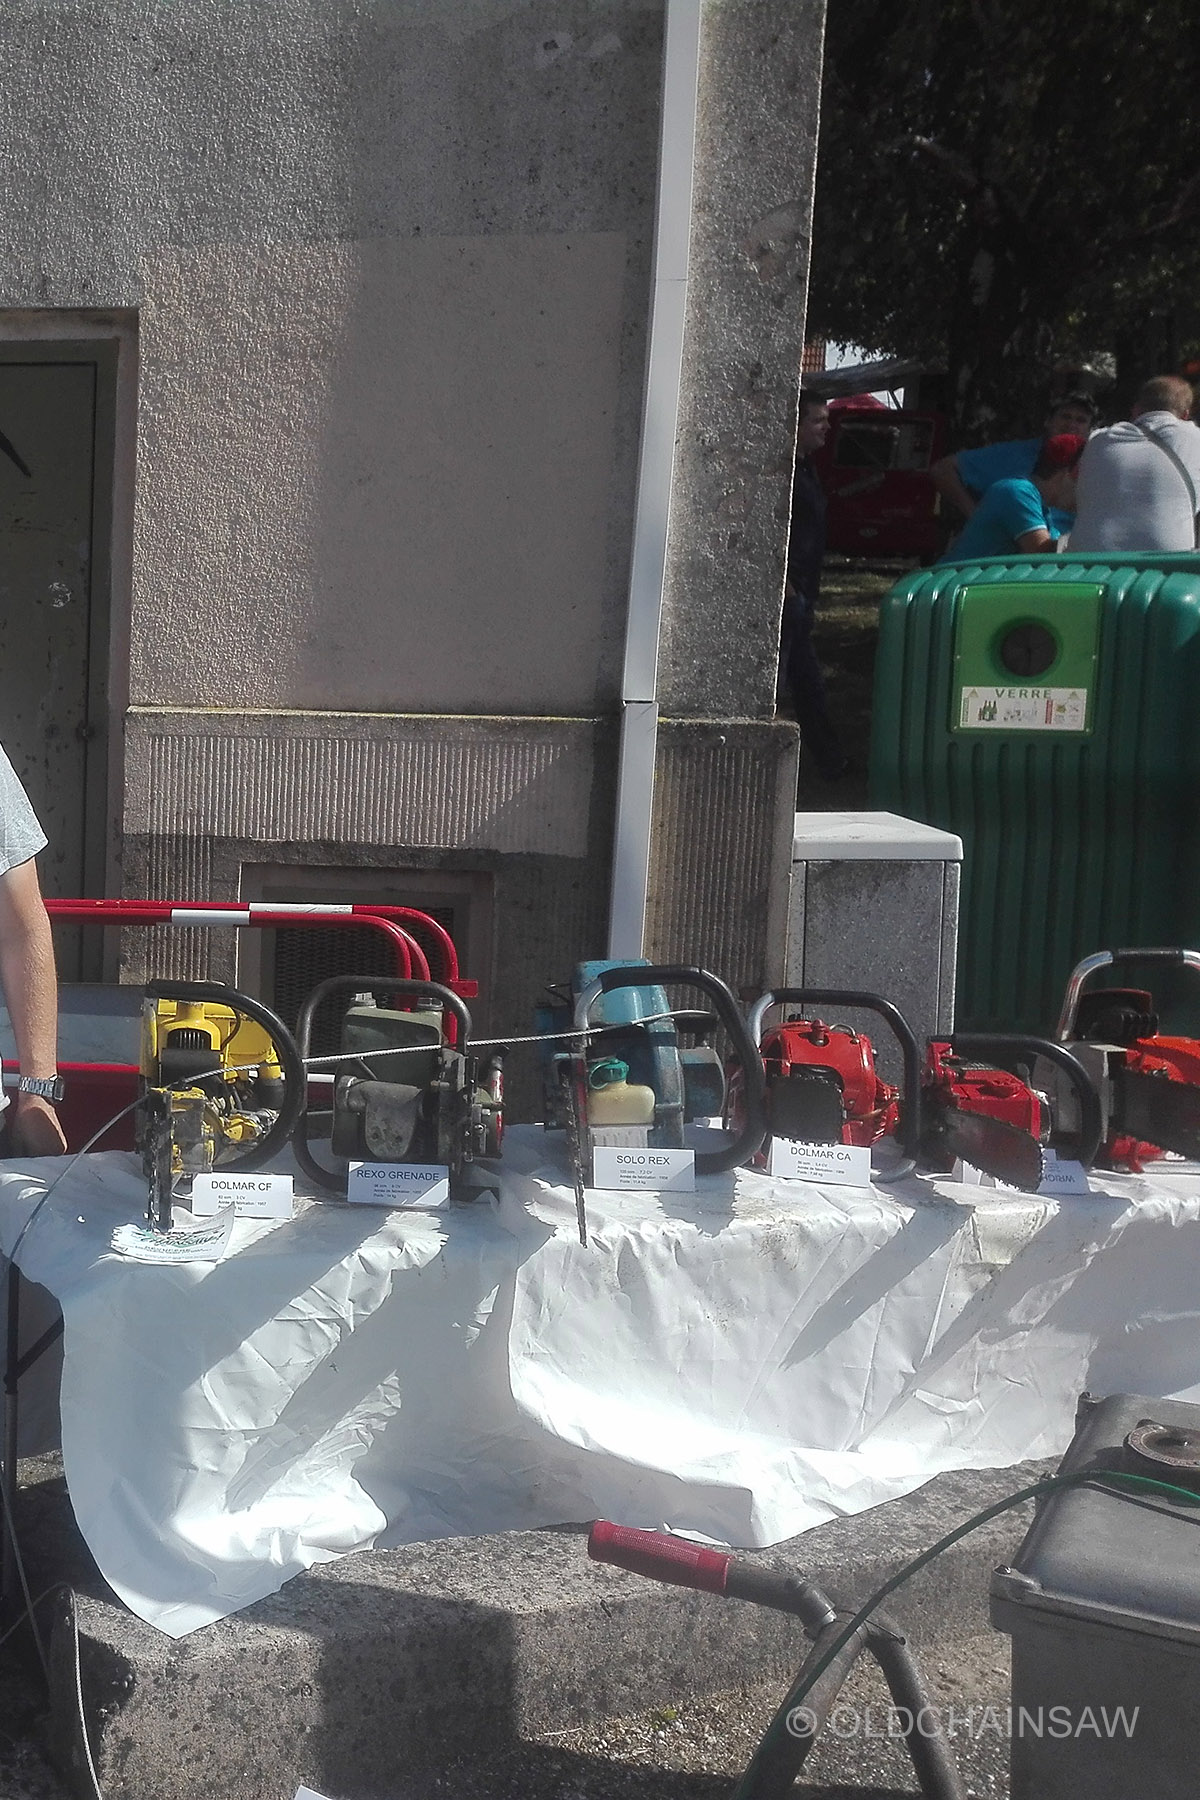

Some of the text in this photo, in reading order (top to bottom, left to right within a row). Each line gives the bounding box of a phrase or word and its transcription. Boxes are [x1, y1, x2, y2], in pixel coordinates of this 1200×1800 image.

[995, 689, 1052, 699] VERRE
[790, 1146, 851, 1161] DOLMAR CA
[616, 1155, 670, 1165] SOLO REX
[356, 1169, 440, 1181] REXO GRENADE
[211, 1180, 273, 1191] DOLMAR CF
